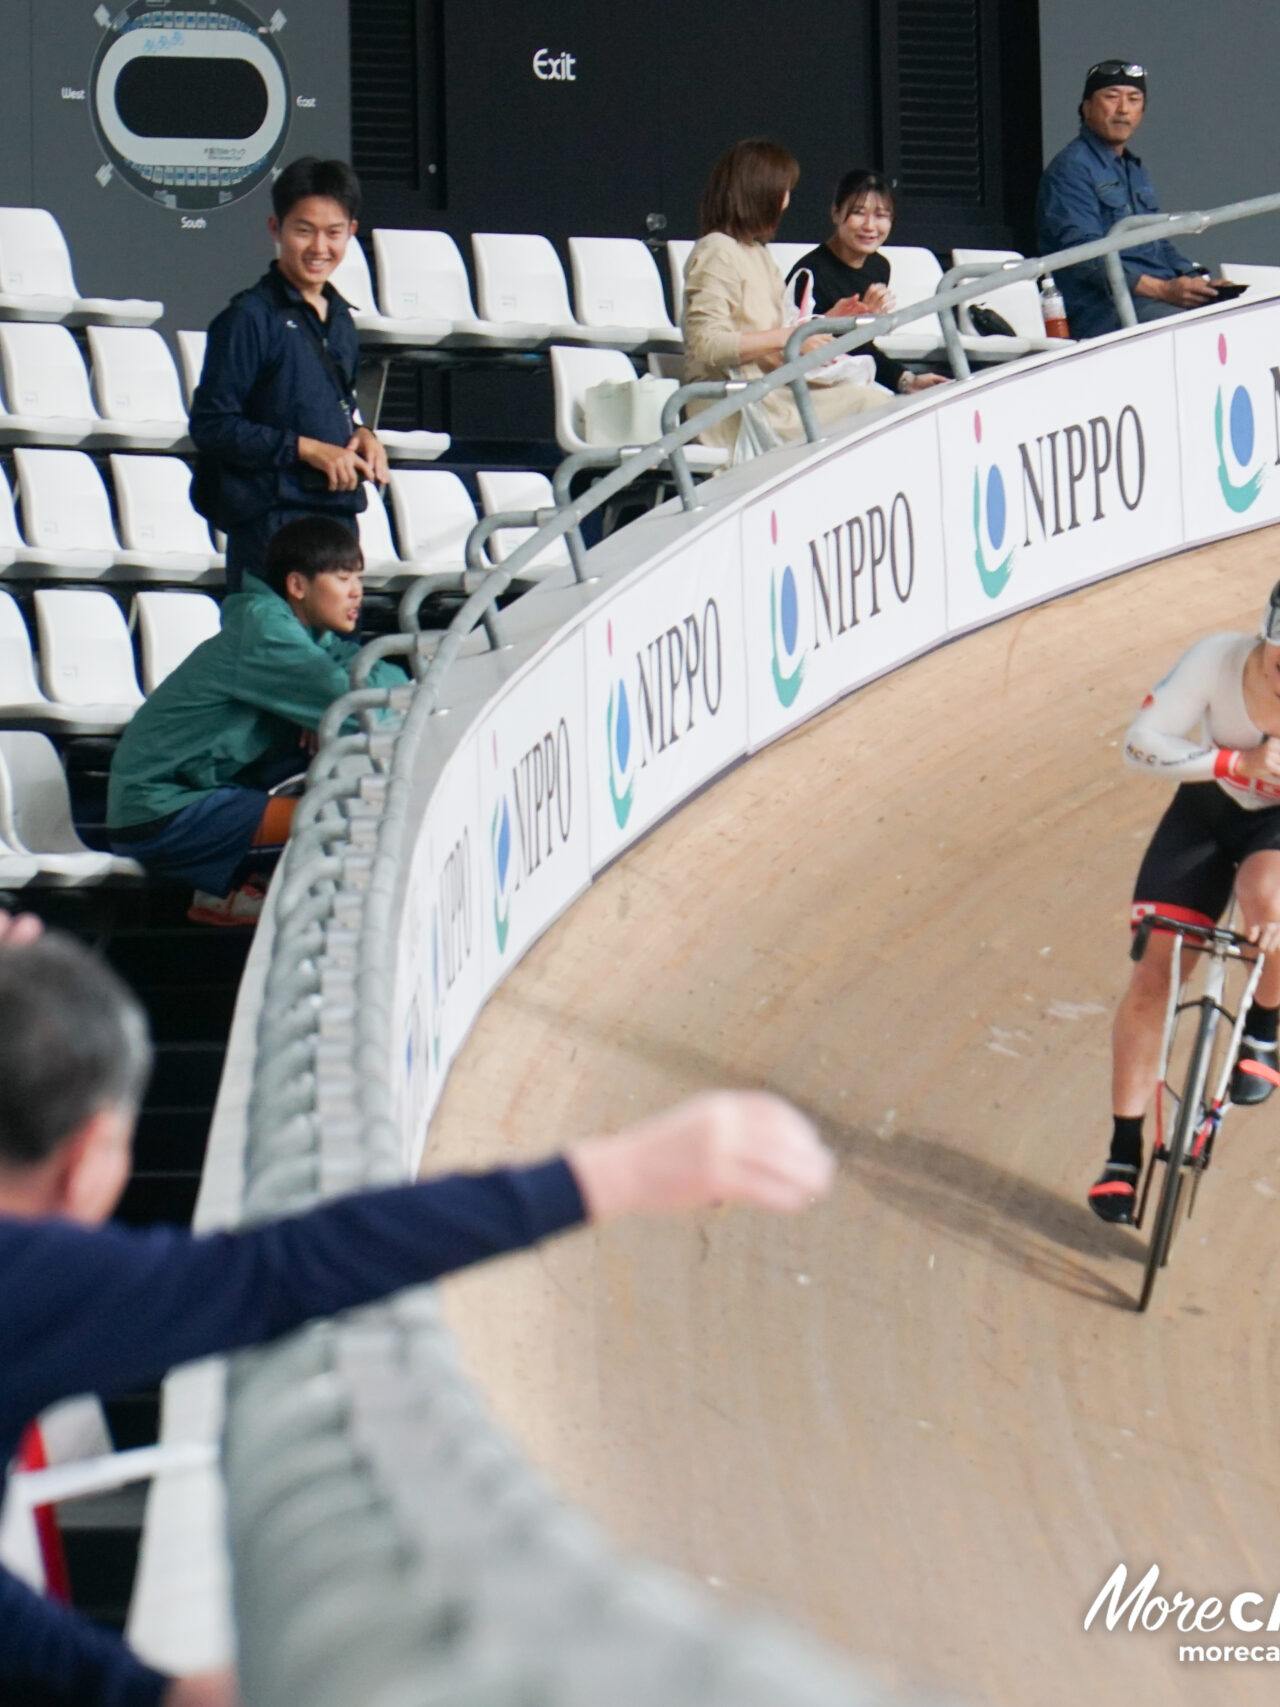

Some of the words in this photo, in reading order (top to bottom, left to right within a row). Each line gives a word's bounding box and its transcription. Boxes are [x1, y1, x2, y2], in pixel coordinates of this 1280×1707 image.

[61, 87, 85, 99] West
[533, 48, 577, 81] Exit
[180, 216, 207, 229] South
[1018, 404, 1146, 548] NIPPO
[808, 491, 915, 650] NIPPO
[636, 597, 723, 768] NIPPO
[512, 716, 572, 891] NIPPO
